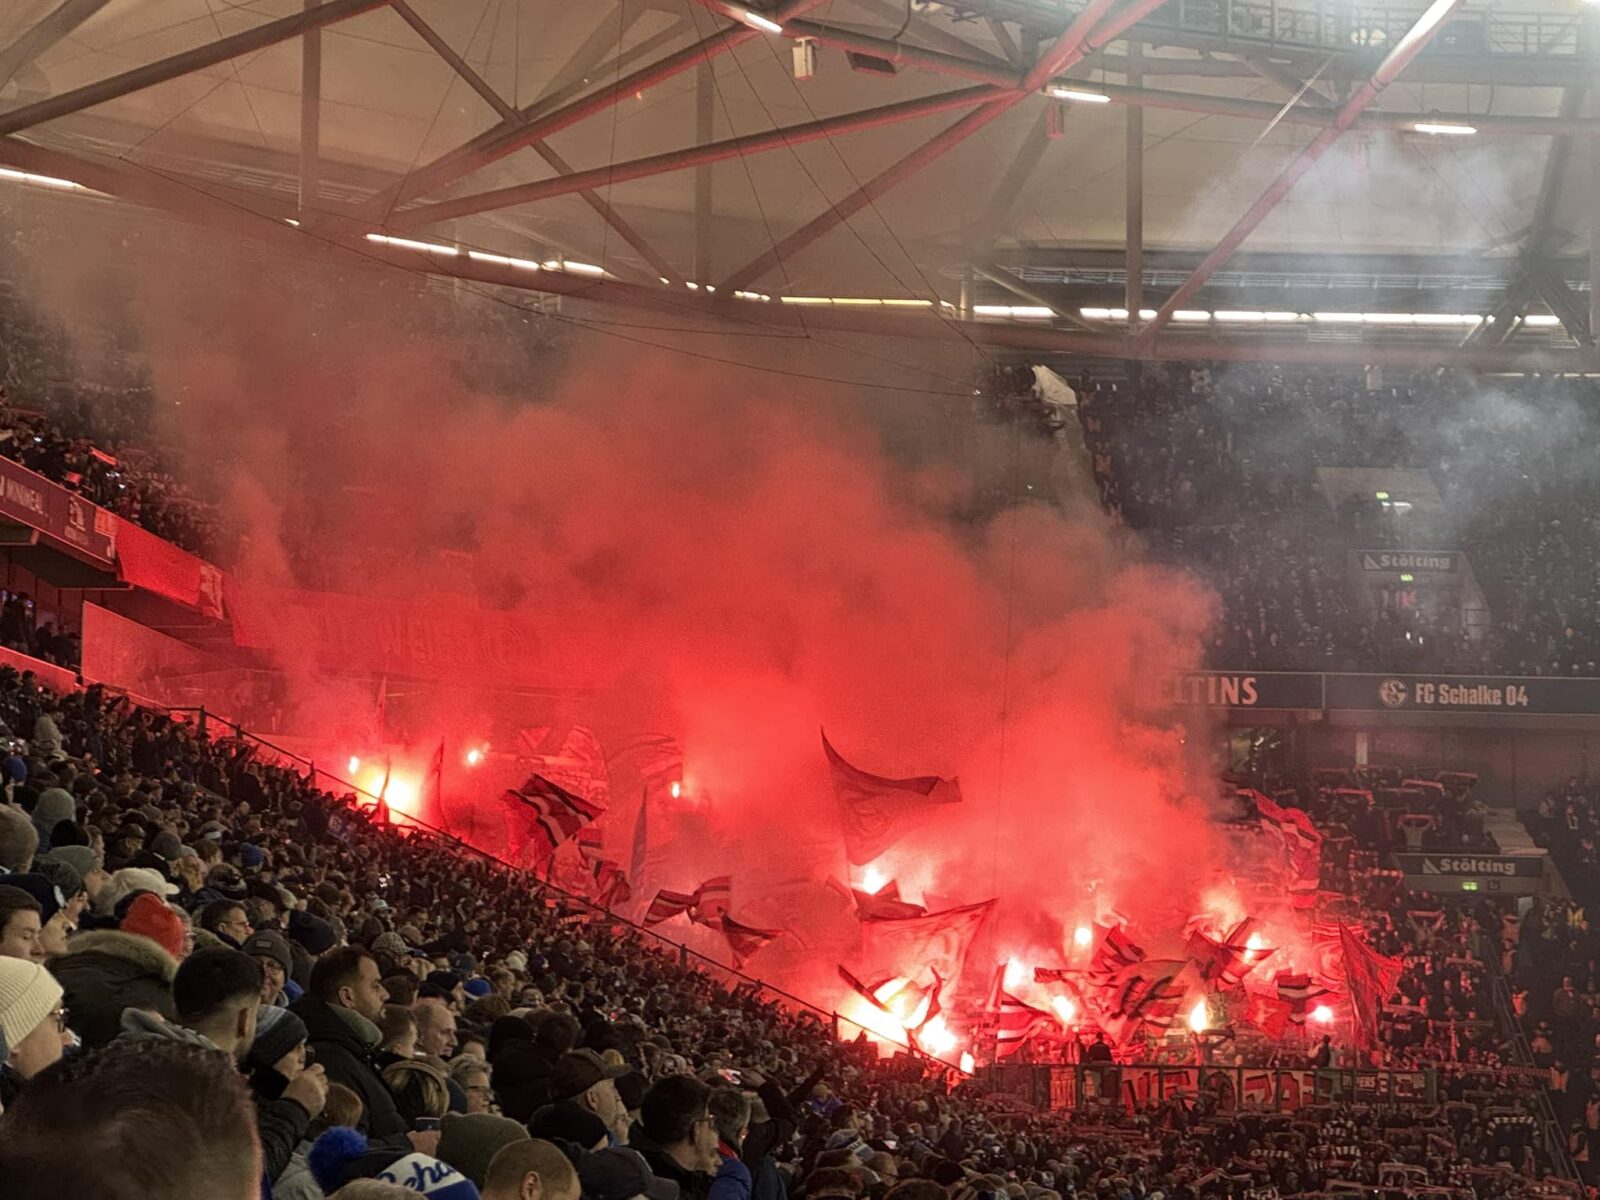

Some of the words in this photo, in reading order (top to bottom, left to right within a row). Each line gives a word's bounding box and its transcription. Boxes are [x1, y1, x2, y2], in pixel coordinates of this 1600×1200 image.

[1380, 554, 1451, 570] Stölting
[1415, 682, 1435, 704] FC
[1438, 683, 1503, 706] Schalke
[1505, 685, 1529, 707] 04
[1439, 857, 1516, 876] Stölting
